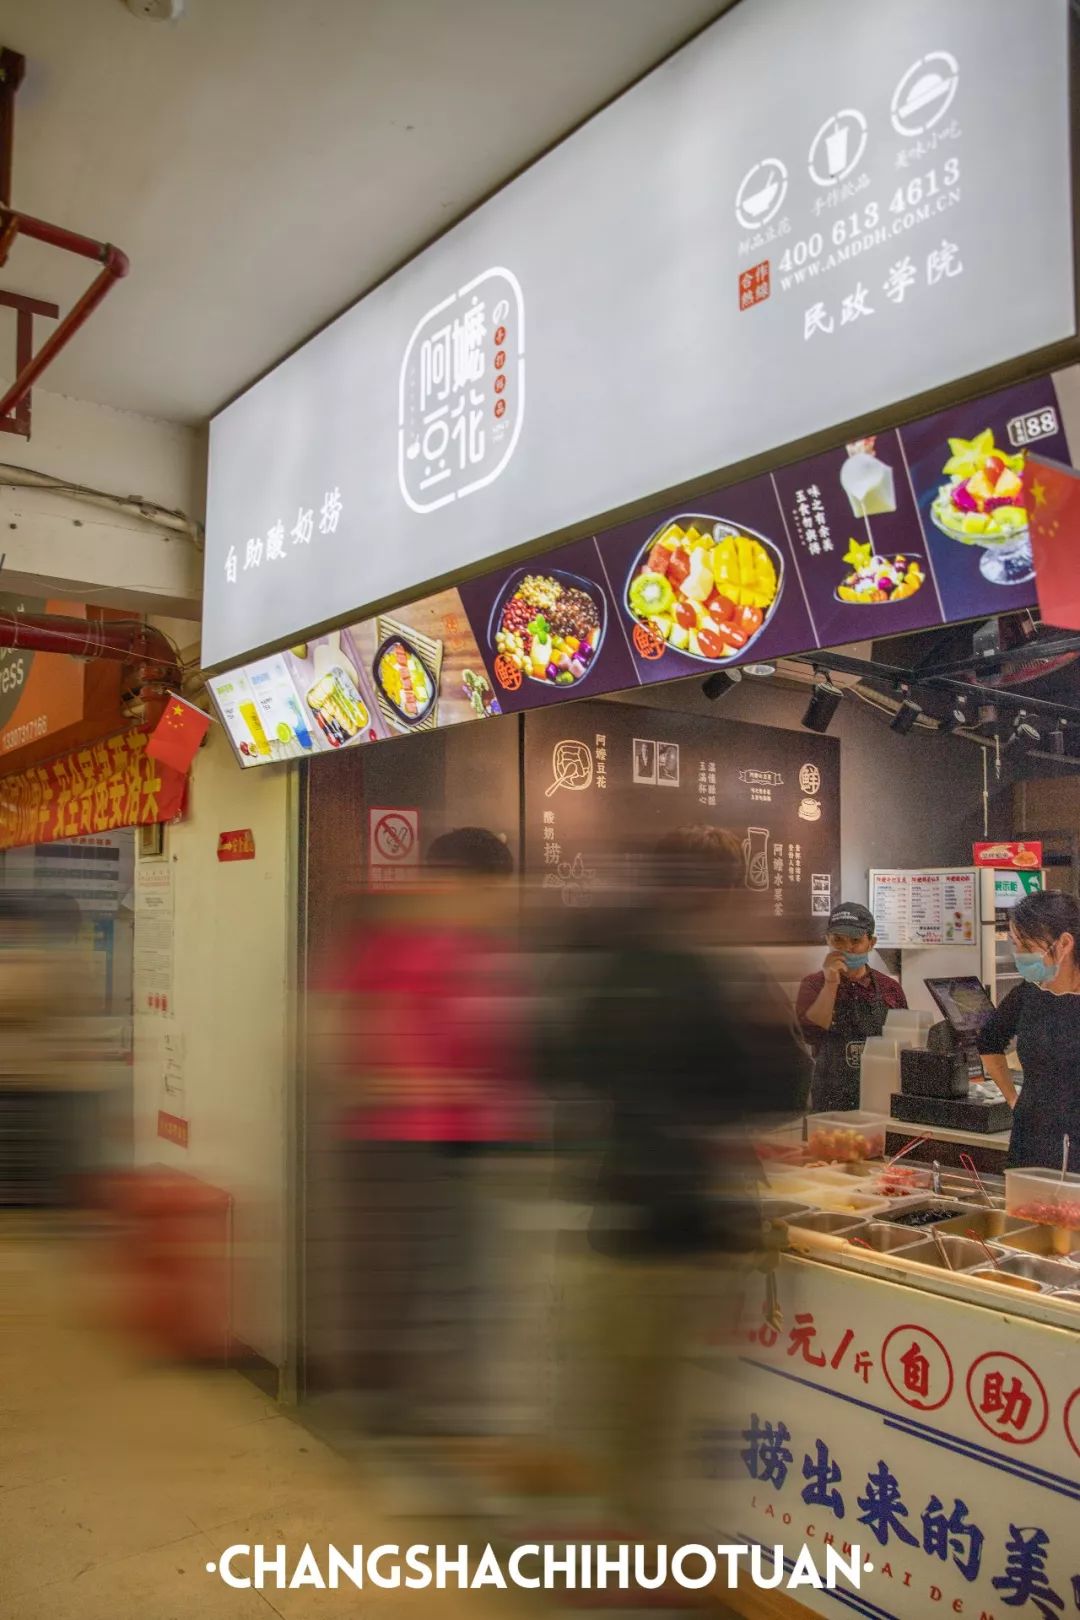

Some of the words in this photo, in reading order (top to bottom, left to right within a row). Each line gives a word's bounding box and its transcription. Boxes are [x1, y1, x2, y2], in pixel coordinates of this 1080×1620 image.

[778, 233, 822, 272] 400
[832, 202, 879, 245] 613
[888, 157, 960, 213] 4613
[804, 239, 964, 340] 民政学院
[224, 487, 343, 584] 自助酸奶捞
[0, 658, 24, 693] ess
[741, 1413, 1080, 1620] 捞出来的美
